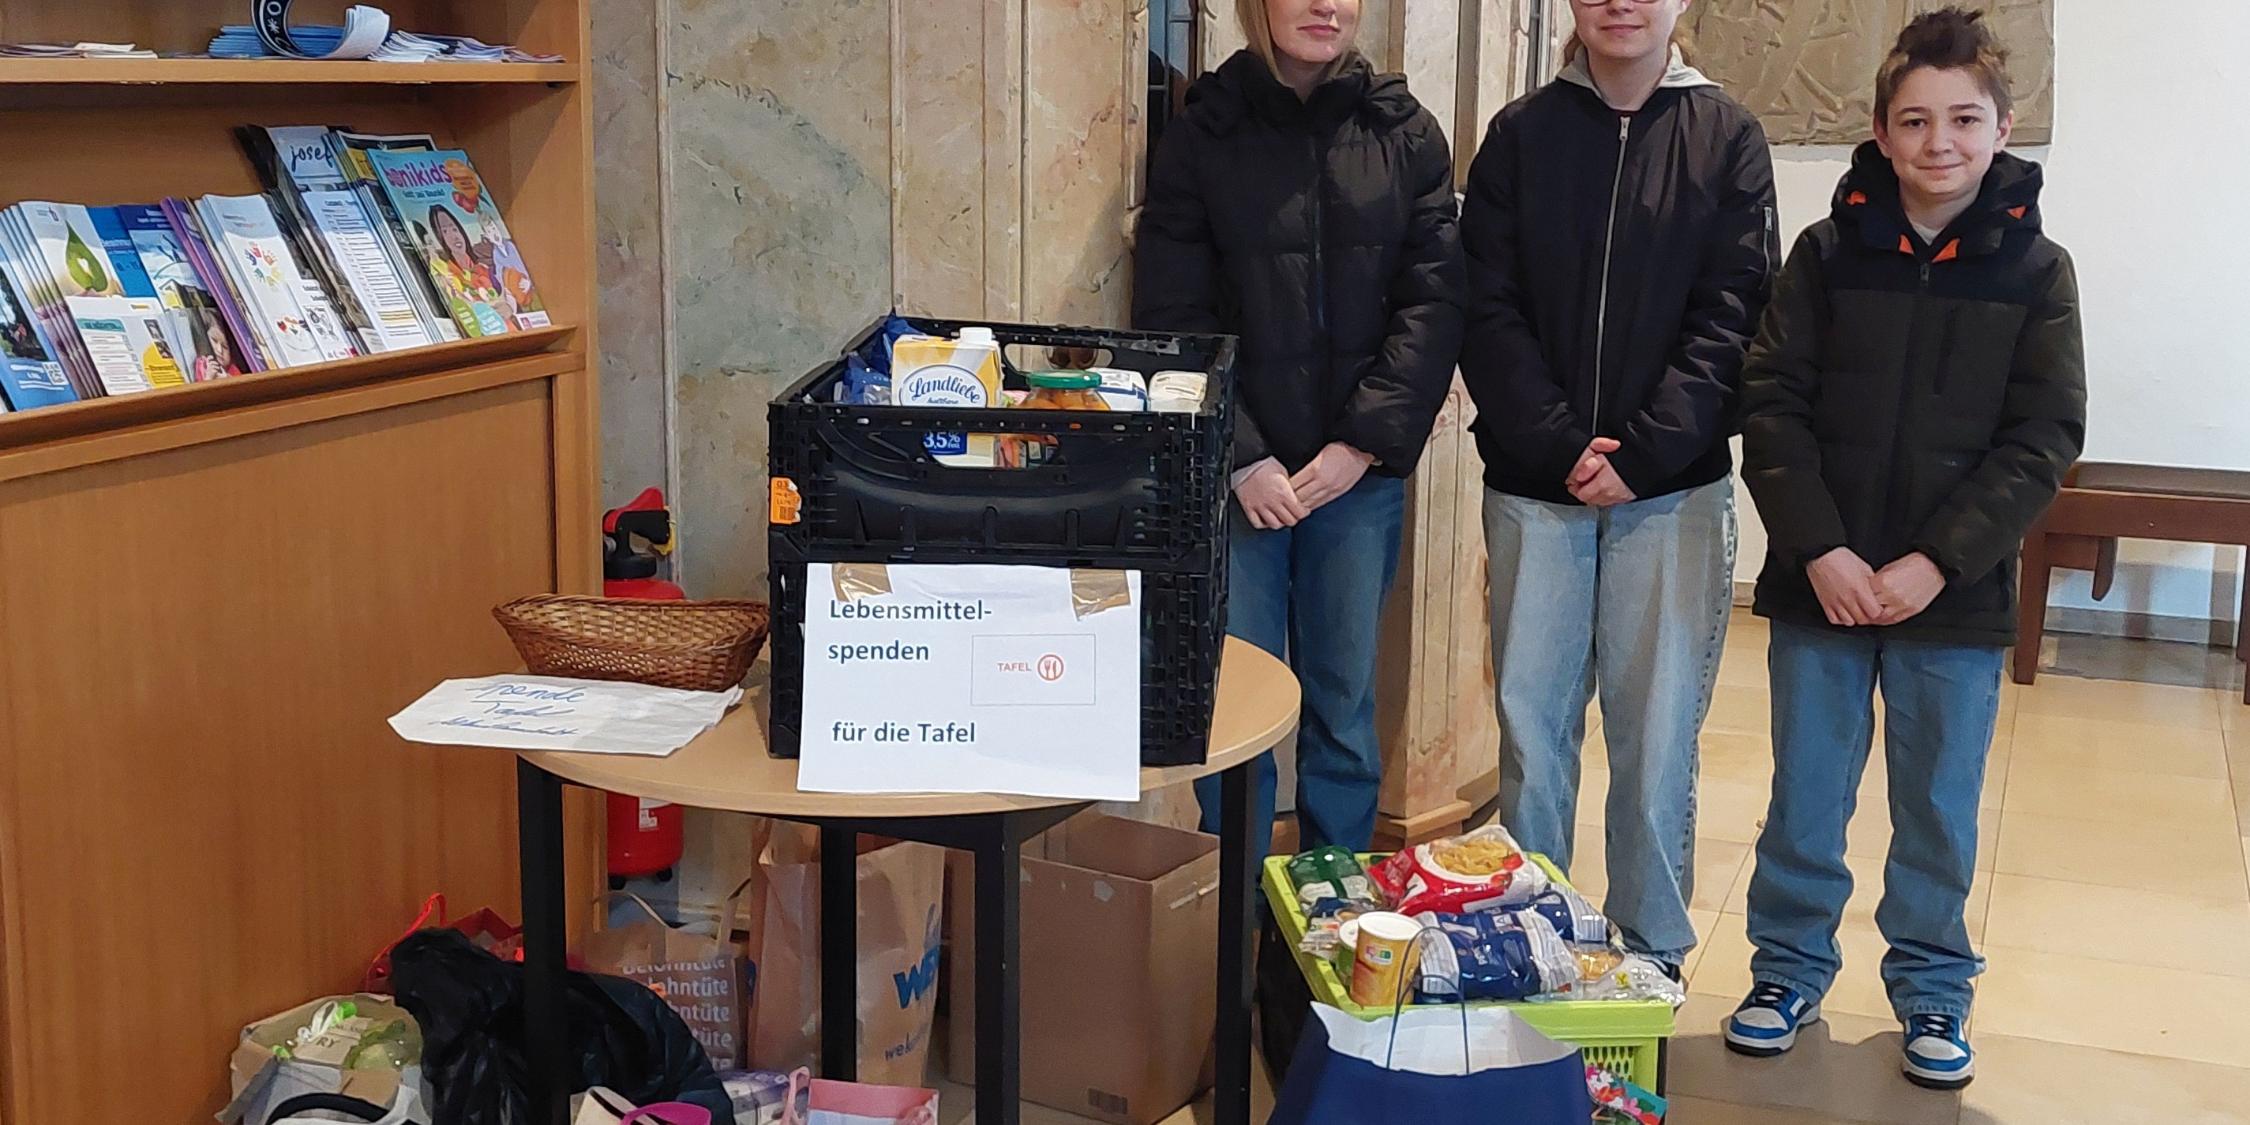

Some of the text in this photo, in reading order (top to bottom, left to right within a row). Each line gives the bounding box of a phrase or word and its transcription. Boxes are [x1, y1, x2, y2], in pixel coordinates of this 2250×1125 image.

[289, 144, 334, 173] josef
[909, 375, 981, 404] Landliebe
[829, 599, 993, 621] Lebensmittel-
[827, 640, 929, 664] spenden
[997, 661, 1033, 672] TAFEL
[832, 721, 976, 743] für die Tafel
